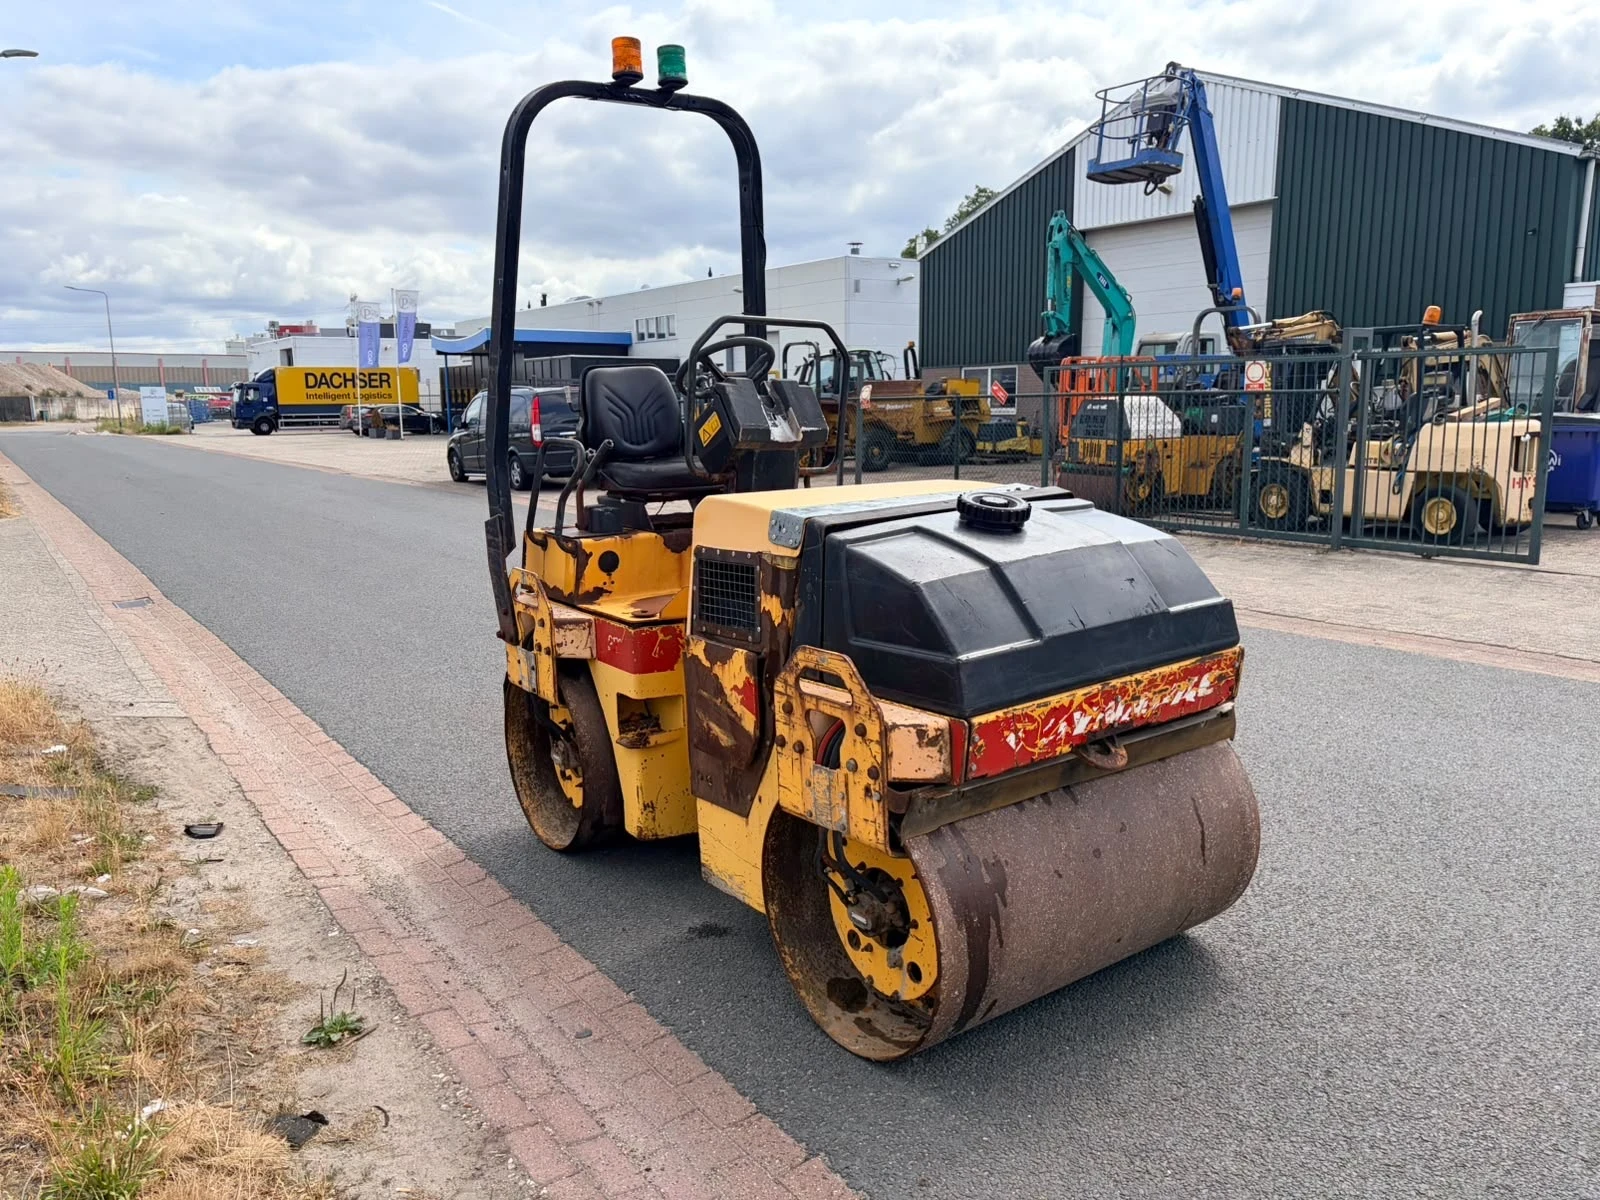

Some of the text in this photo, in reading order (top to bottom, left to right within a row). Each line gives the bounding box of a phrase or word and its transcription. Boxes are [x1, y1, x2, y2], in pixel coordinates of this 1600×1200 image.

[304, 372, 391, 389] DACHSER
[306, 392, 392, 401] Intelligent Logistics
